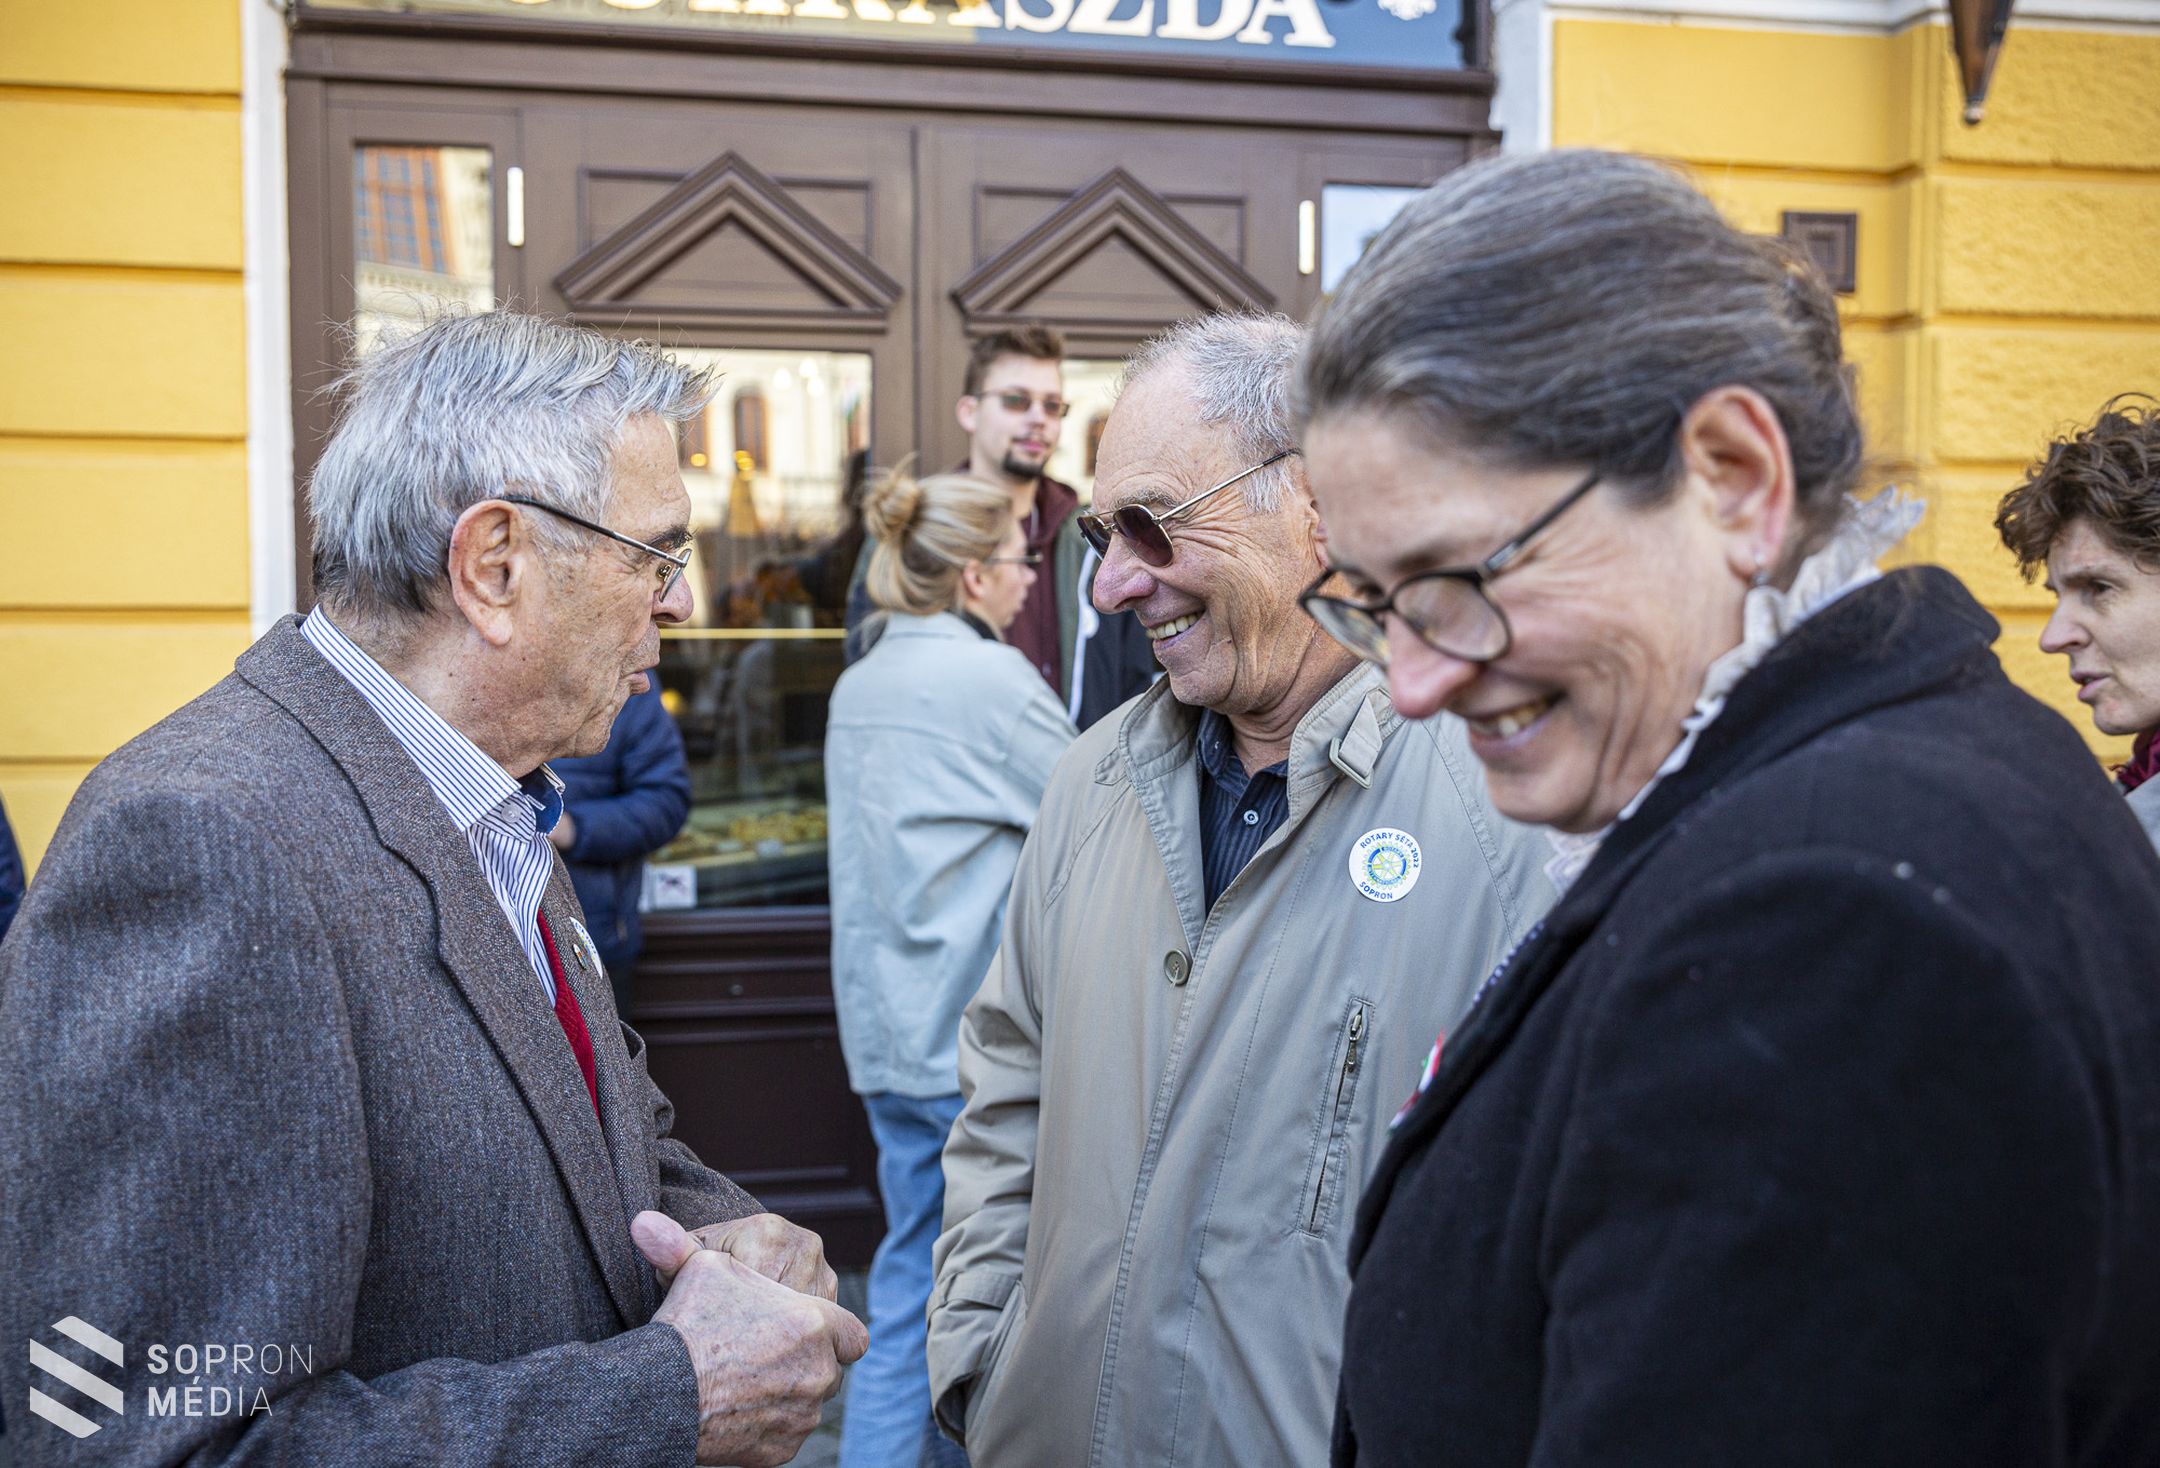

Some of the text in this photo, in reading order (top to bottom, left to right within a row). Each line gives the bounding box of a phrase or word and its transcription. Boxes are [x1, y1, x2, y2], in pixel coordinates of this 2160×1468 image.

[1360, 832, 1393, 848] ROTARY
[1411, 847, 1420, 868] 2022
[1359, 881, 1393, 899] SOPRON
